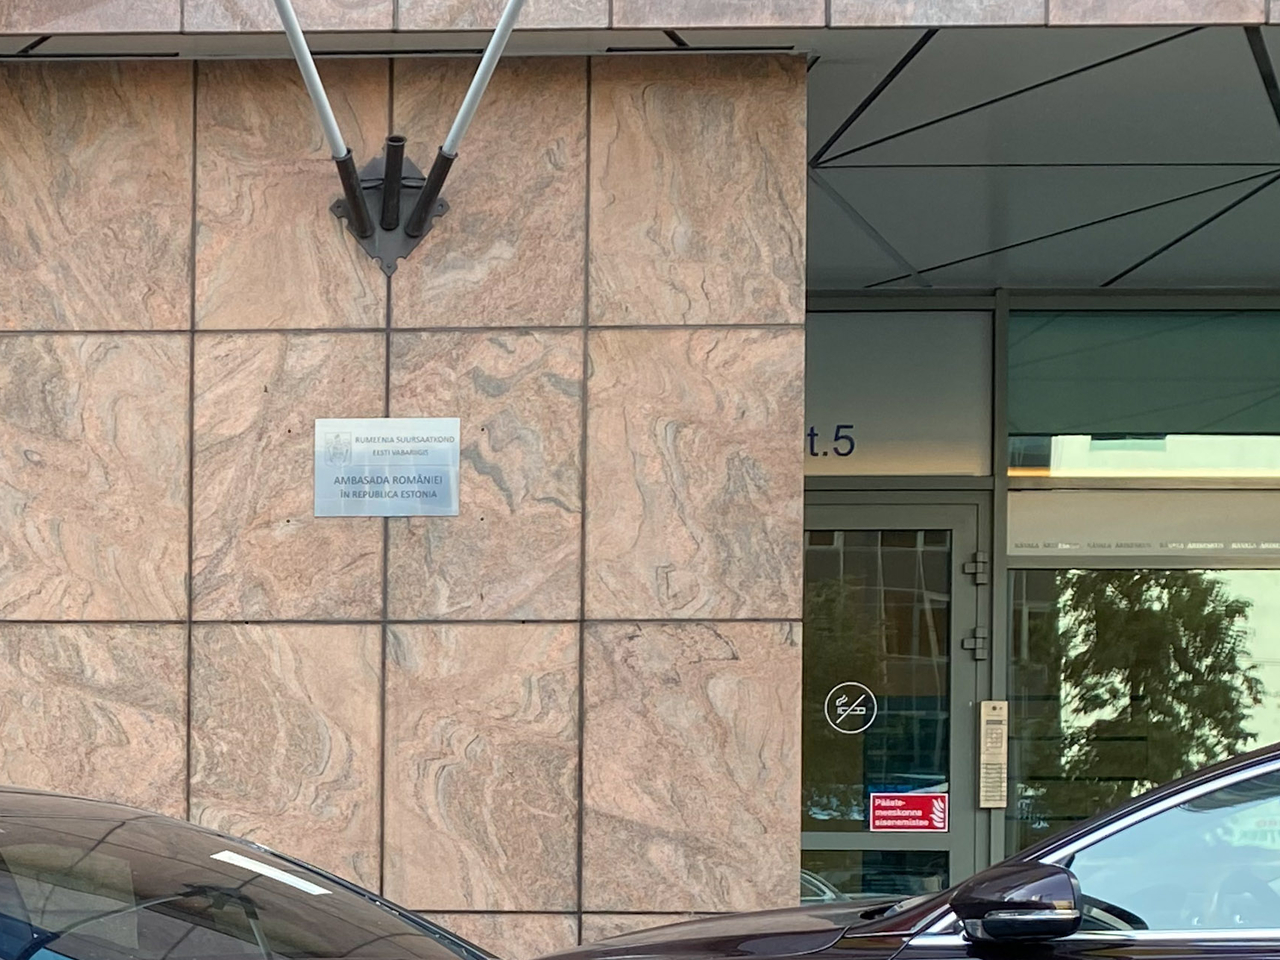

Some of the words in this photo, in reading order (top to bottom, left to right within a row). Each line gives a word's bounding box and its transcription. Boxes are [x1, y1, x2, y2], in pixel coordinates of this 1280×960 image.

[355, 436, 395, 444] RUMEENIA
[396, 436, 455, 444] SUURSAATKOND
[334, 476, 390, 485] AMBASADA
[392, 473, 443, 485] ROMÂNIEI
[340, 488, 350, 498] ÎN
[352, 490, 399, 499] REPUBLICA
[401, 490, 438, 498] ESTONIA
